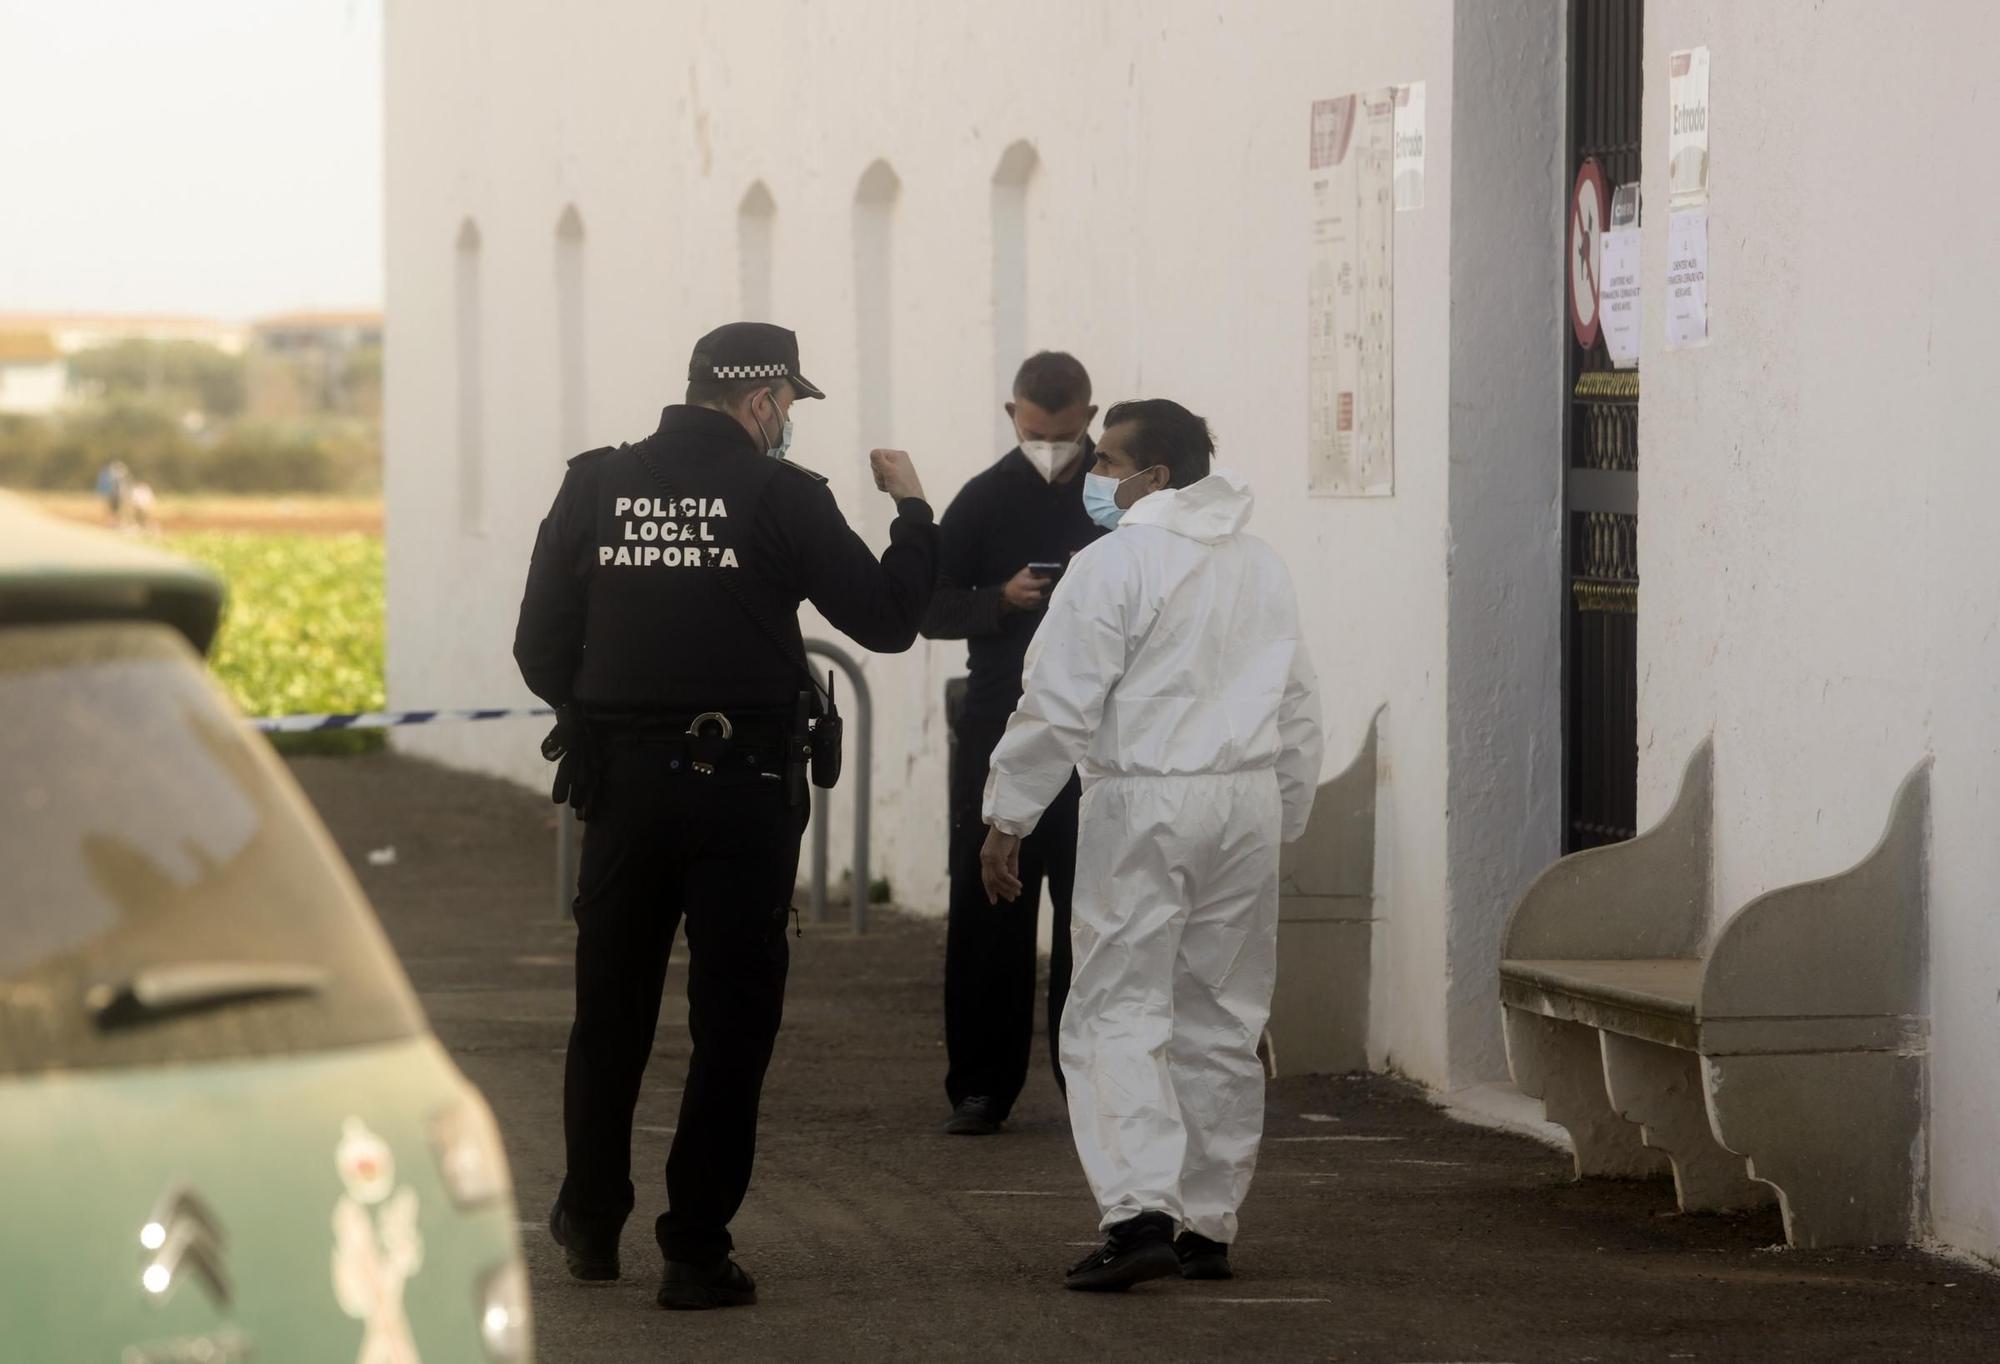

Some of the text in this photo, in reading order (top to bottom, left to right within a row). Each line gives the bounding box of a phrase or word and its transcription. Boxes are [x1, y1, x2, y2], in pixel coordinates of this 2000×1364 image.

[1673, 99, 1705, 136] Entrada
[615, 497, 728, 518] POLICIA
[624, 521, 714, 541] LOCAL
